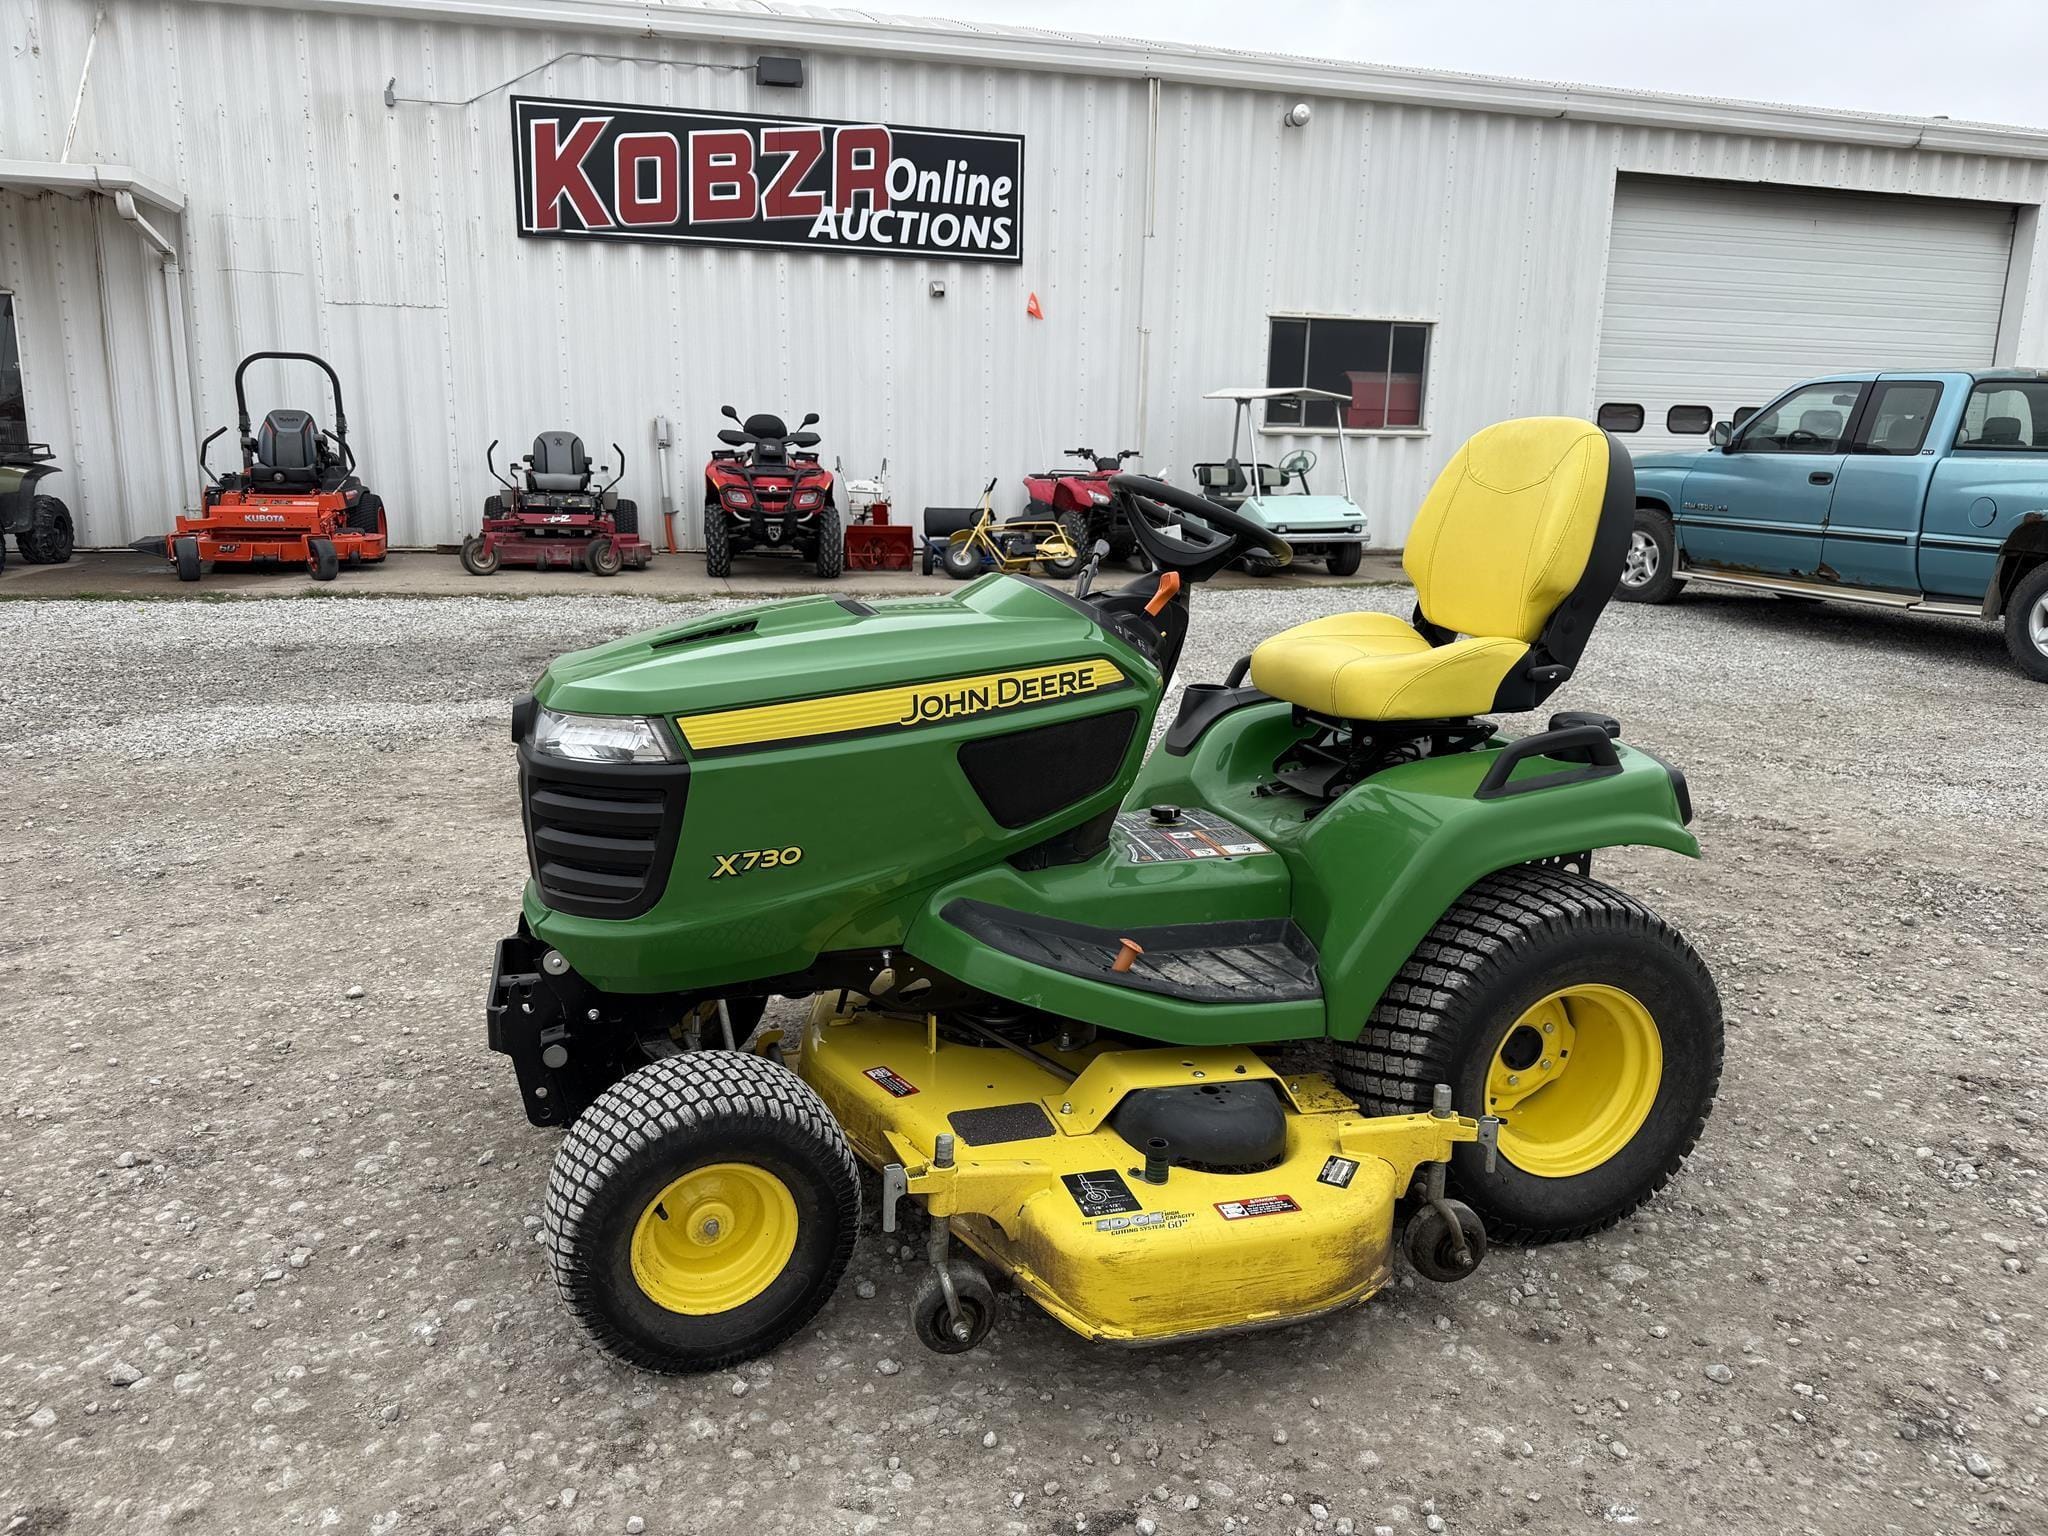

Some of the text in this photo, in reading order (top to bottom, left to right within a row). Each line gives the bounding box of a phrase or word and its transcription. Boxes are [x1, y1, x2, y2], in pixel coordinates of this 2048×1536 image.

[529, 115, 1012, 231] KOBZA Online
[807, 203, 1013, 251] AUCTIONS
[244, 514, 286, 523] KUBOTA
[900, 666, 1096, 724] JOHN DEERE
[708, 845, 804, 880] X730
[1096, 1211, 1166, 1232] EDGE
[1139, 1223, 1166, 1232] SYSTEM
[1165, 1212, 1195, 1221] CAPACITY
